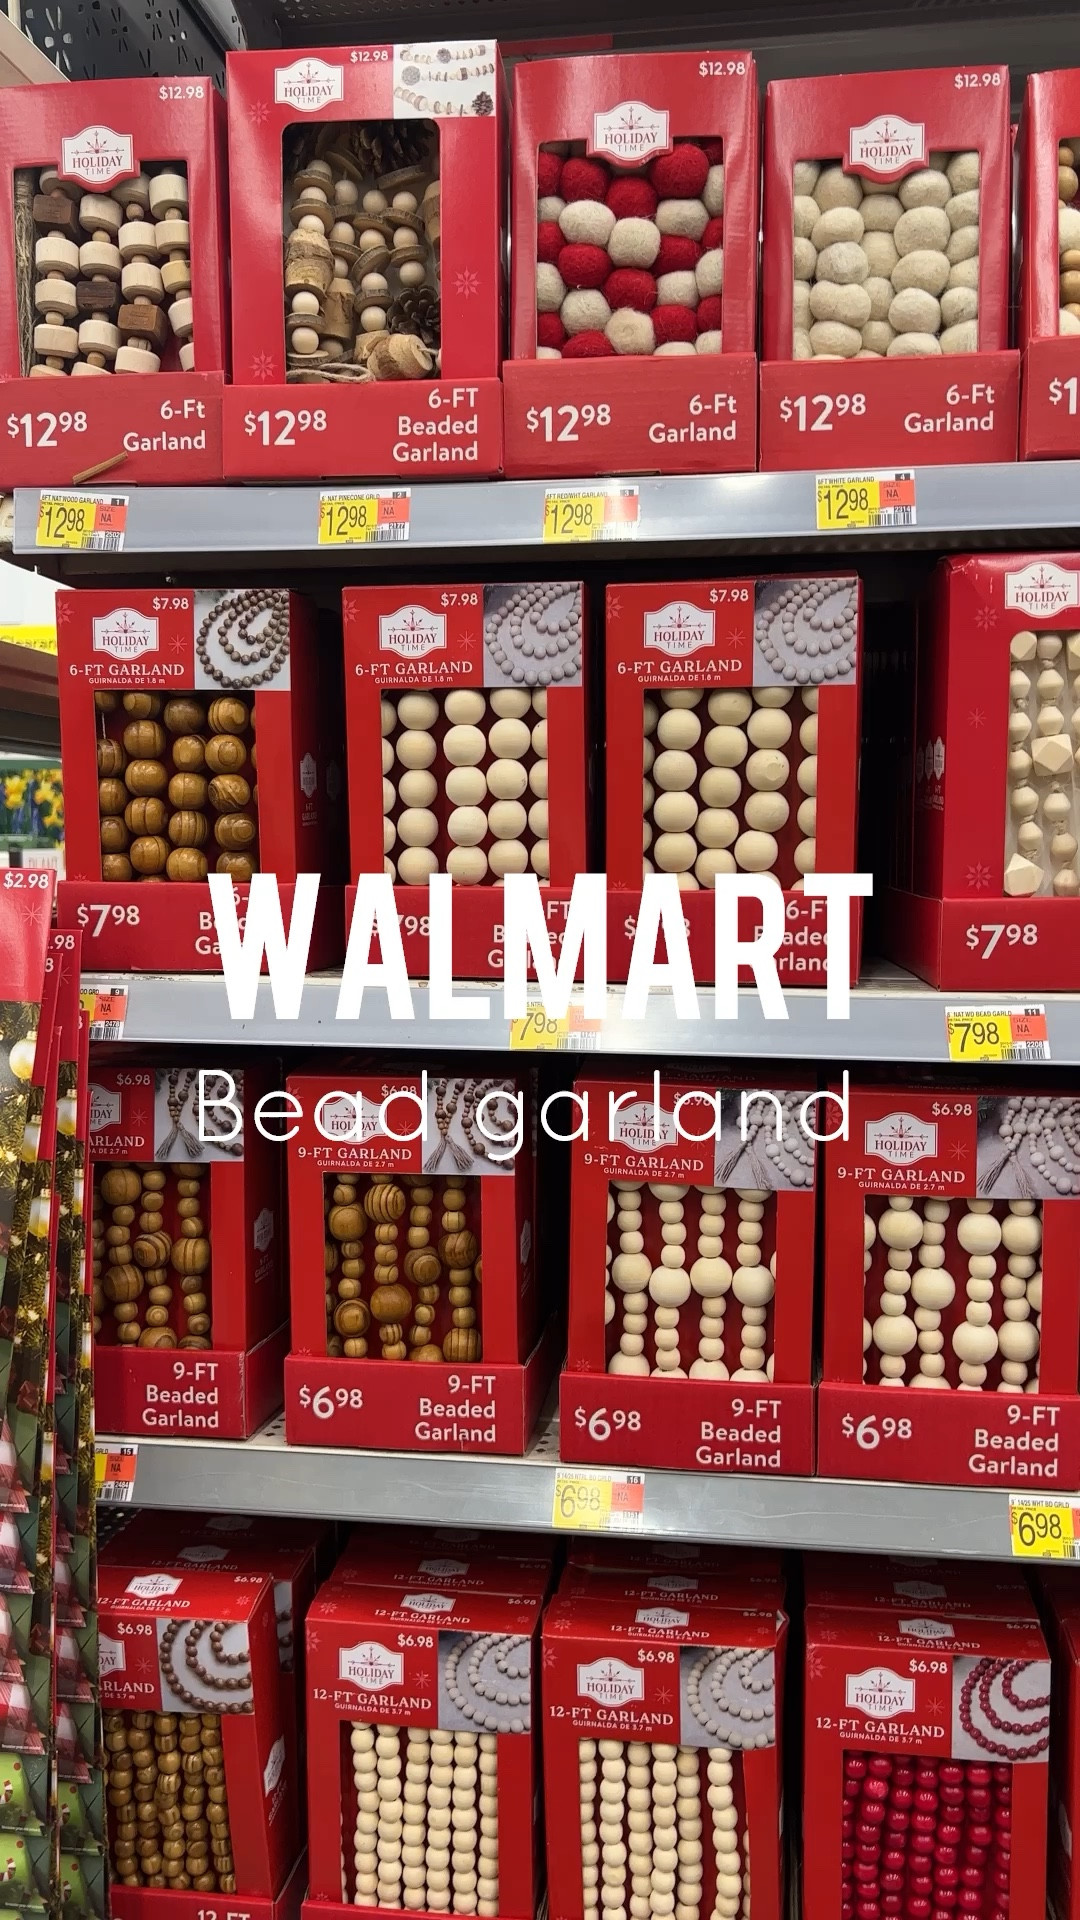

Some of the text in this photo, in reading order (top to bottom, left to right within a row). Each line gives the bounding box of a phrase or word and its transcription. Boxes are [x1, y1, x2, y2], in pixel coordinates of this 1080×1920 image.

[350, 51, 388, 63] $12.98
[699, 61, 745, 78] $12.98
[954, 73, 1001, 89] $12.98
[159, 85, 204, 100] $12.98
[284, 85, 334, 98] HOLIDAY
[604, 132, 658, 145] HOLIDAY
[618, 144, 644, 152] TIME
[860, 144, 913, 159] HOLIDAY
[72, 156, 123, 168] HOLIDAY
[874, 157, 900, 165] TIME
[85, 167, 111, 175] TIME
[428, 387, 479, 408] 6-FT
[946, 383, 994, 405] 6-Ft
[160, 399, 205, 420] 6-Ft
[689, 393, 737, 415] 6-Ft
[398, 414, 479, 436] Beaded
[904, 411, 994, 433] Garland
[649, 420, 736, 443] Garland
[123, 430, 206, 451] Garland
[392, 441, 479, 462] Garland
[101, 513, 111, 522] NA
[384, 507, 394, 515] NA
[441, 593, 478, 607] $7.98
[709, 589, 748, 603] $7.98
[1016, 591, 1069, 602] HOLIDAY
[153, 596, 189, 610] $7.98
[102, 636, 149, 646] HOLIDAY
[389, 633, 437, 645] HOLIDAY
[654, 631, 705, 642] HOLIDAY
[69, 664, 185, 676] 6-FT GARLAND
[355, 661, 473, 676] 6-FT GARLAND
[617, 660, 742, 674] 6-FT GARLAND
[374, 676, 419, 684] GUIRNALDA
[638, 674, 685, 682] GUIRNALDA
[3, 871, 48, 889] $2.98
[101, 1004, 111, 1012] NA
[1017, 1024, 1030, 1032] NA
[116, 1074, 150, 1086] $6.98
[932, 1102, 972, 1117] $6.98
[631, 1138, 656, 1146] TIME
[875, 1140, 927, 1152] HOLIDAY
[298, 1147, 412, 1160] 9-FT GARLAND
[888, 1150, 914, 1158] TIME
[584, 1153, 704, 1171] 9-FT GARLAND
[603, 1167, 650, 1176] GUIRNALDA
[837, 1167, 965, 1183] 9-FT GARLAND
[858, 1181, 907, 1189] GUIRNALDA
[173, 1362, 219, 1381] 9-FT
[448, 1375, 496, 1394] 9-FT
[146, 1384, 219, 1405] Beaded
[420, 1398, 495, 1418] Beaded
[732, 1398, 781, 1419] 9-FT
[142, 1408, 219, 1428] Garland
[1007, 1404, 1060, 1426] 9-FT
[414, 1422, 496, 1443] Garland
[701, 1421, 780, 1443] Beaded
[974, 1429, 1059, 1452] Beaded
[696, 1446, 780, 1468] Garland
[111, 1463, 121, 1472] NA
[968, 1454, 1058, 1477] Garland
[617, 1492, 628, 1501] NA
[131, 1598, 191, 1608] GARLAND
[410, 1612, 470, 1624] GARLAND
[117, 1623, 152, 1635] $6.98
[652, 1627, 710, 1638] GARLAND
[397, 1633, 434, 1648] $6.98
[917, 1638, 981, 1649] GARLAND
[637, 1649, 675, 1663] $6.98
[348, 1666, 395, 1678] HOLIDAY
[909, 1659, 948, 1674] $6.98
[360, 1677, 383, 1685] TIME
[587, 1682, 635, 1695] HOLIDAY
[313, 1688, 431, 1709] 12-FT GARLAND
[855, 1693, 905, 1706] HOLIDAY
[334, 1703, 378, 1713] GUIRNALDA
[868, 1705, 893, 1713] TIME
[549, 1705, 674, 1725] 12-FT GARLAND
[573, 1720, 617, 1730] GUIRNALDA
[815, 1717, 945, 1738] 12-FT GARLAND
[839, 1731, 887, 1741] GUIRNALDA
[889, 1735, 899, 1743] DE
